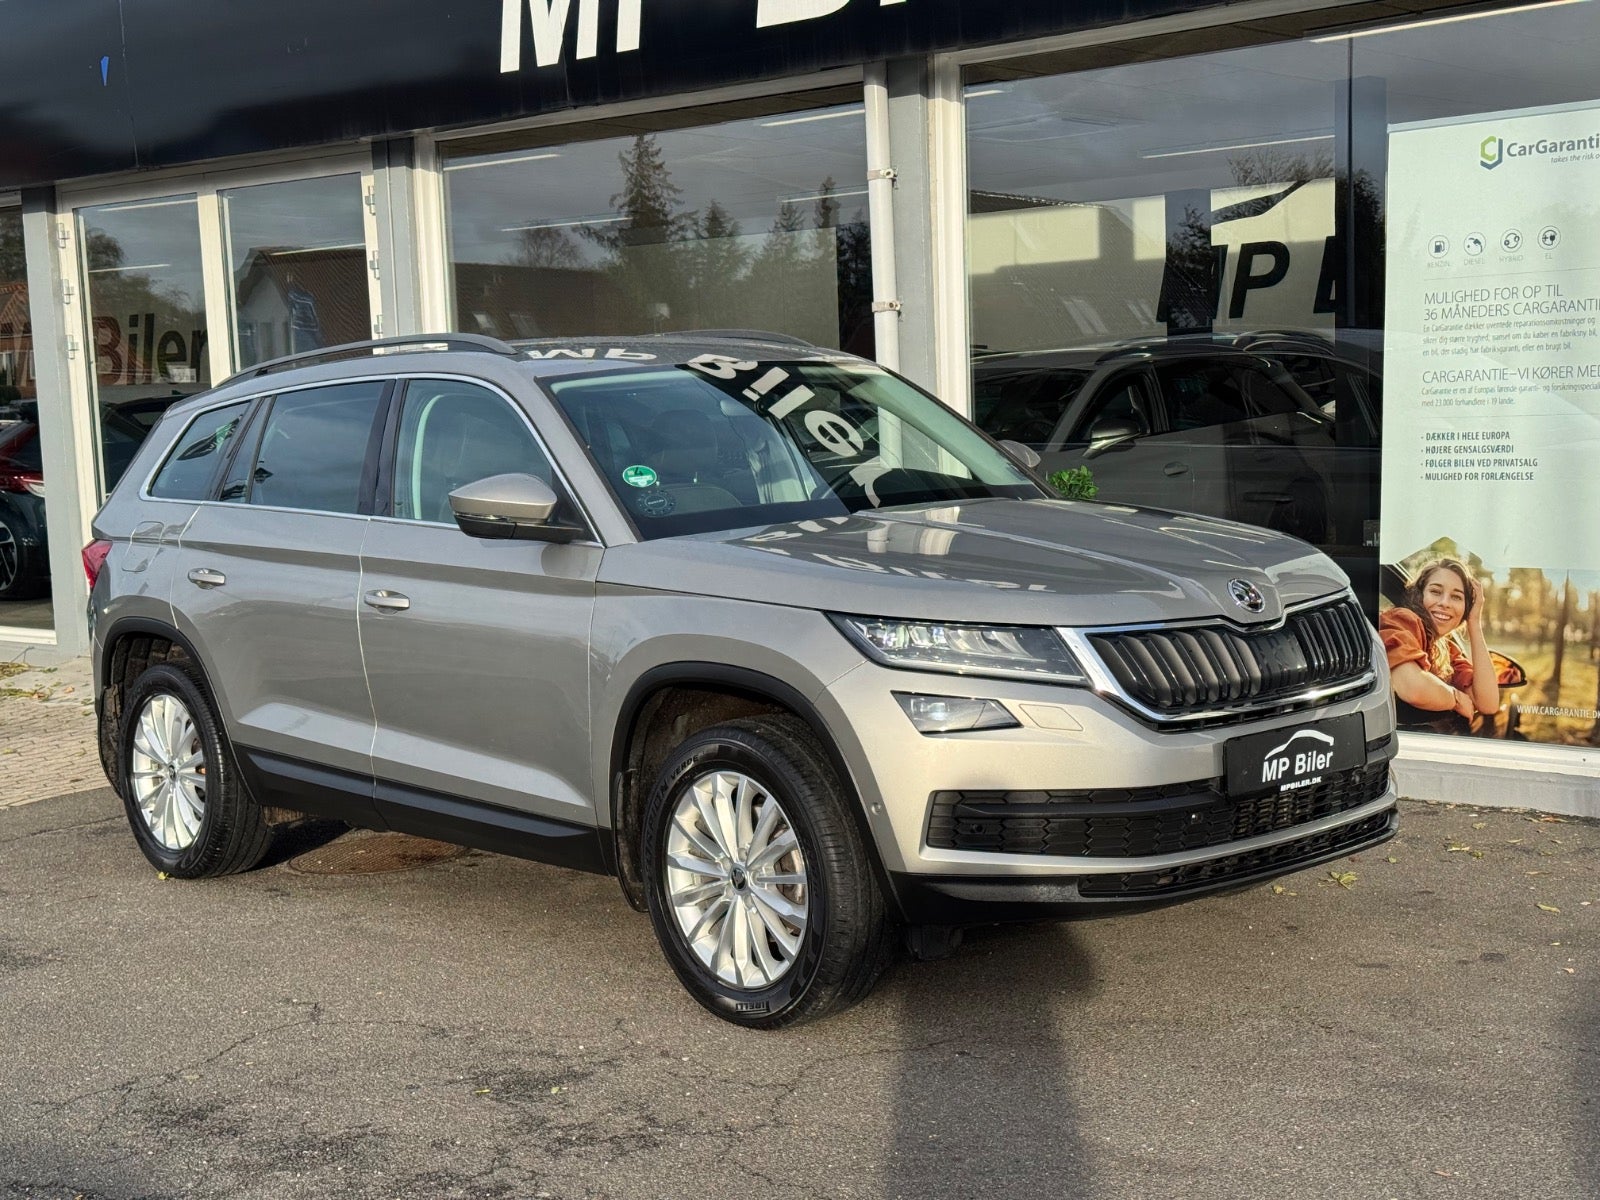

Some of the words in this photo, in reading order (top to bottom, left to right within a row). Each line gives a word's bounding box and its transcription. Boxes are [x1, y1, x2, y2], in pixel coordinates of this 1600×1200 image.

[1570, 154, 1581, 162] the
[1463, 257, 1485, 266] DIESEL
[1424, 289, 1490, 305] MULIGHED
[1494, 287, 1519, 301] FOR
[1522, 286, 1541, 299] OP
[1545, 284, 1563, 297] TIL
[1424, 308, 1438, 321] 36
[1441, 303, 1509, 319] MÅNEDERS
[1513, 299, 1600, 315] CARGARANTI
[1532, 365, 1573, 380] KØRER
[1425, 432, 1455, 441] DÆKKER
[1457, 432, 1460, 440] I
[1462, 432, 1480, 440] HELE
[1482, 431, 1510, 440] EUROPA
[1425, 445, 1452, 454] HØJERE
[1454, 444, 1514, 454] GENSALGSVÆRDI
[1425, 459, 1452, 468] FØLGER
[1454, 458, 1475, 467] BILEN
[1477, 458, 1491, 467] VED
[1493, 458, 1538, 467] PRIVATSALG
[1425, 472, 1463, 481] MULIGHED
[1464, 472, 1479, 481] FOR
[1481, 471, 1534, 481] FORLÆNGELSE
[1262, 757, 1290, 783] MP
[1294, 750, 1334, 776] Biler
[1280, 776, 1322, 792] MPBILER.DK
